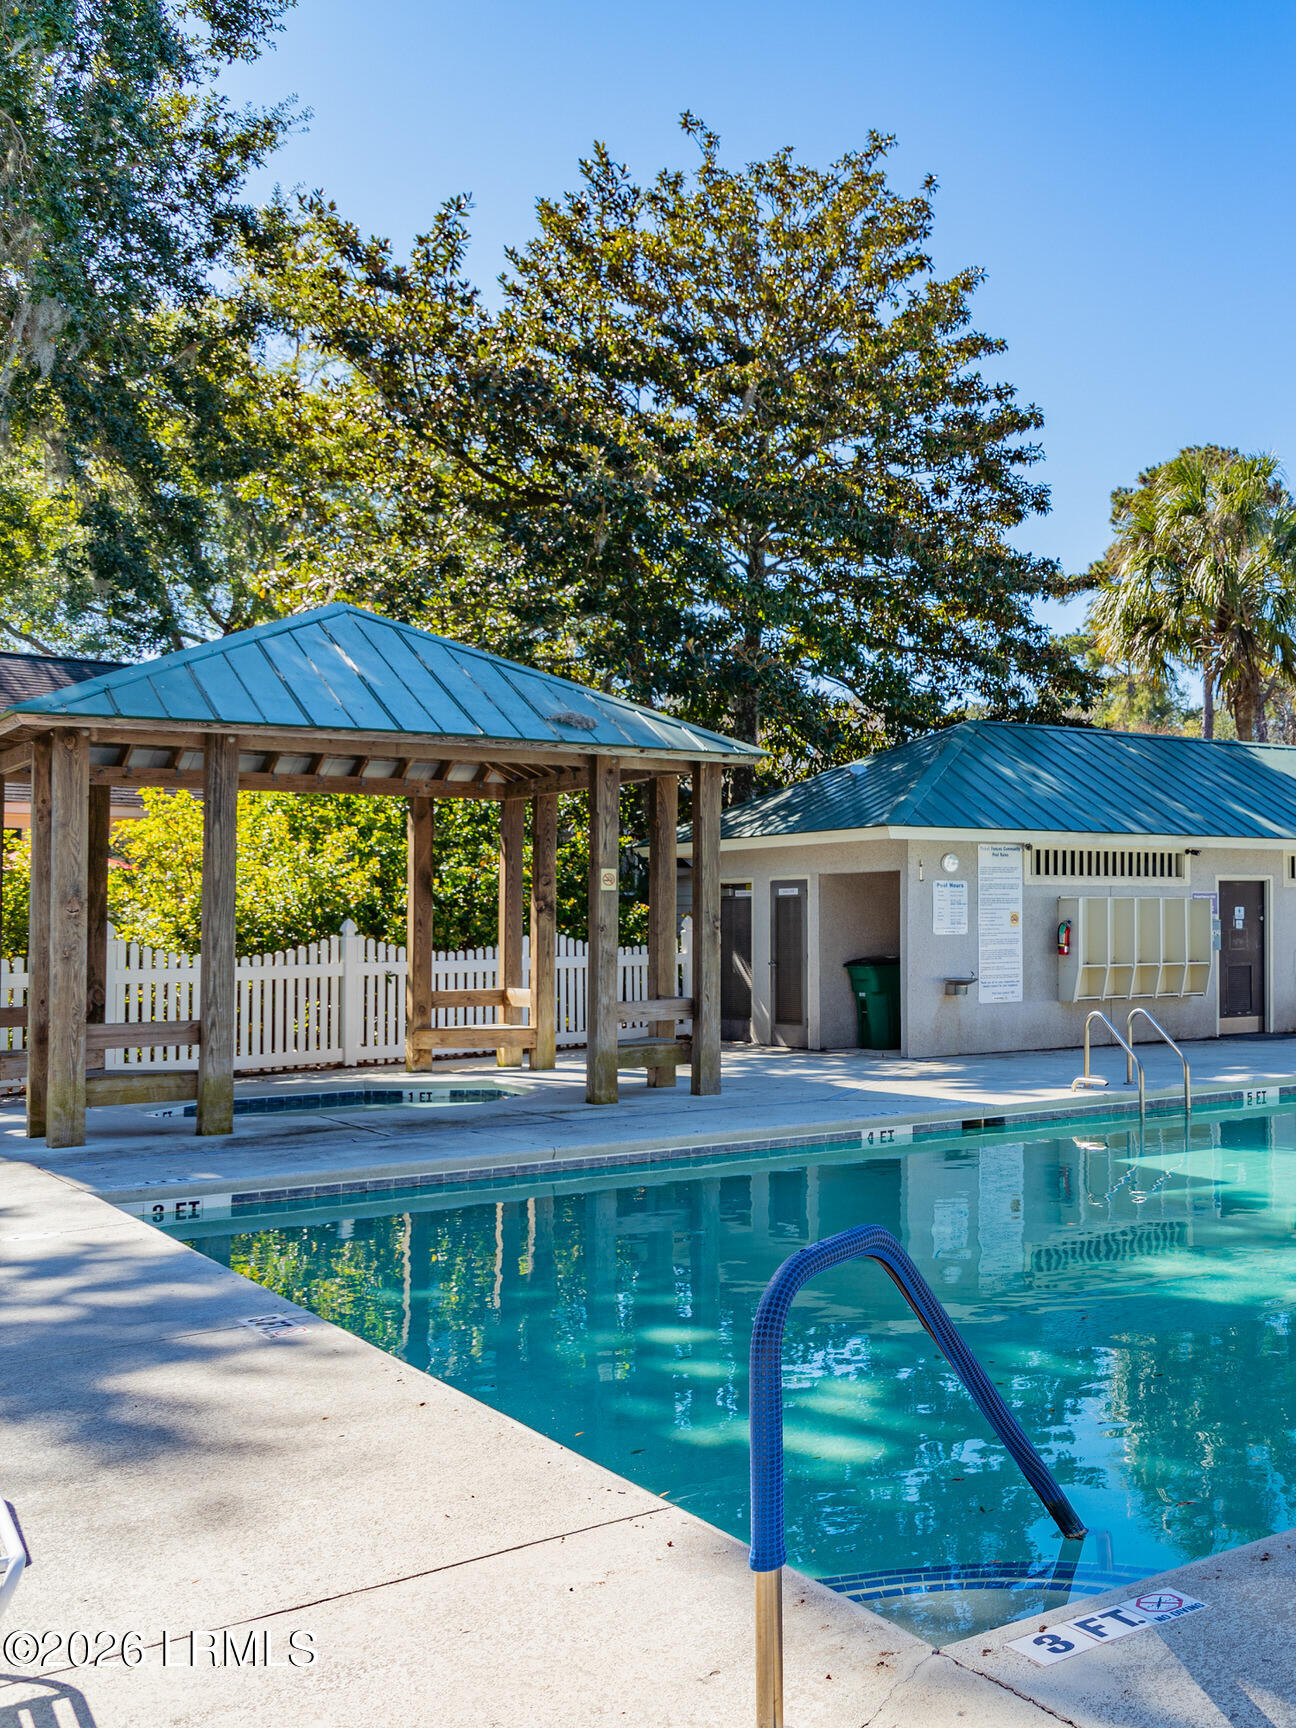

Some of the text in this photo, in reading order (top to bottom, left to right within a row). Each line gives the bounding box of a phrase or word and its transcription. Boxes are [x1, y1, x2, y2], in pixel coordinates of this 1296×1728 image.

[1154, 1602, 1206, 1622] NO DIVING
[1031, 1608, 1147, 1654] 3 FT.
